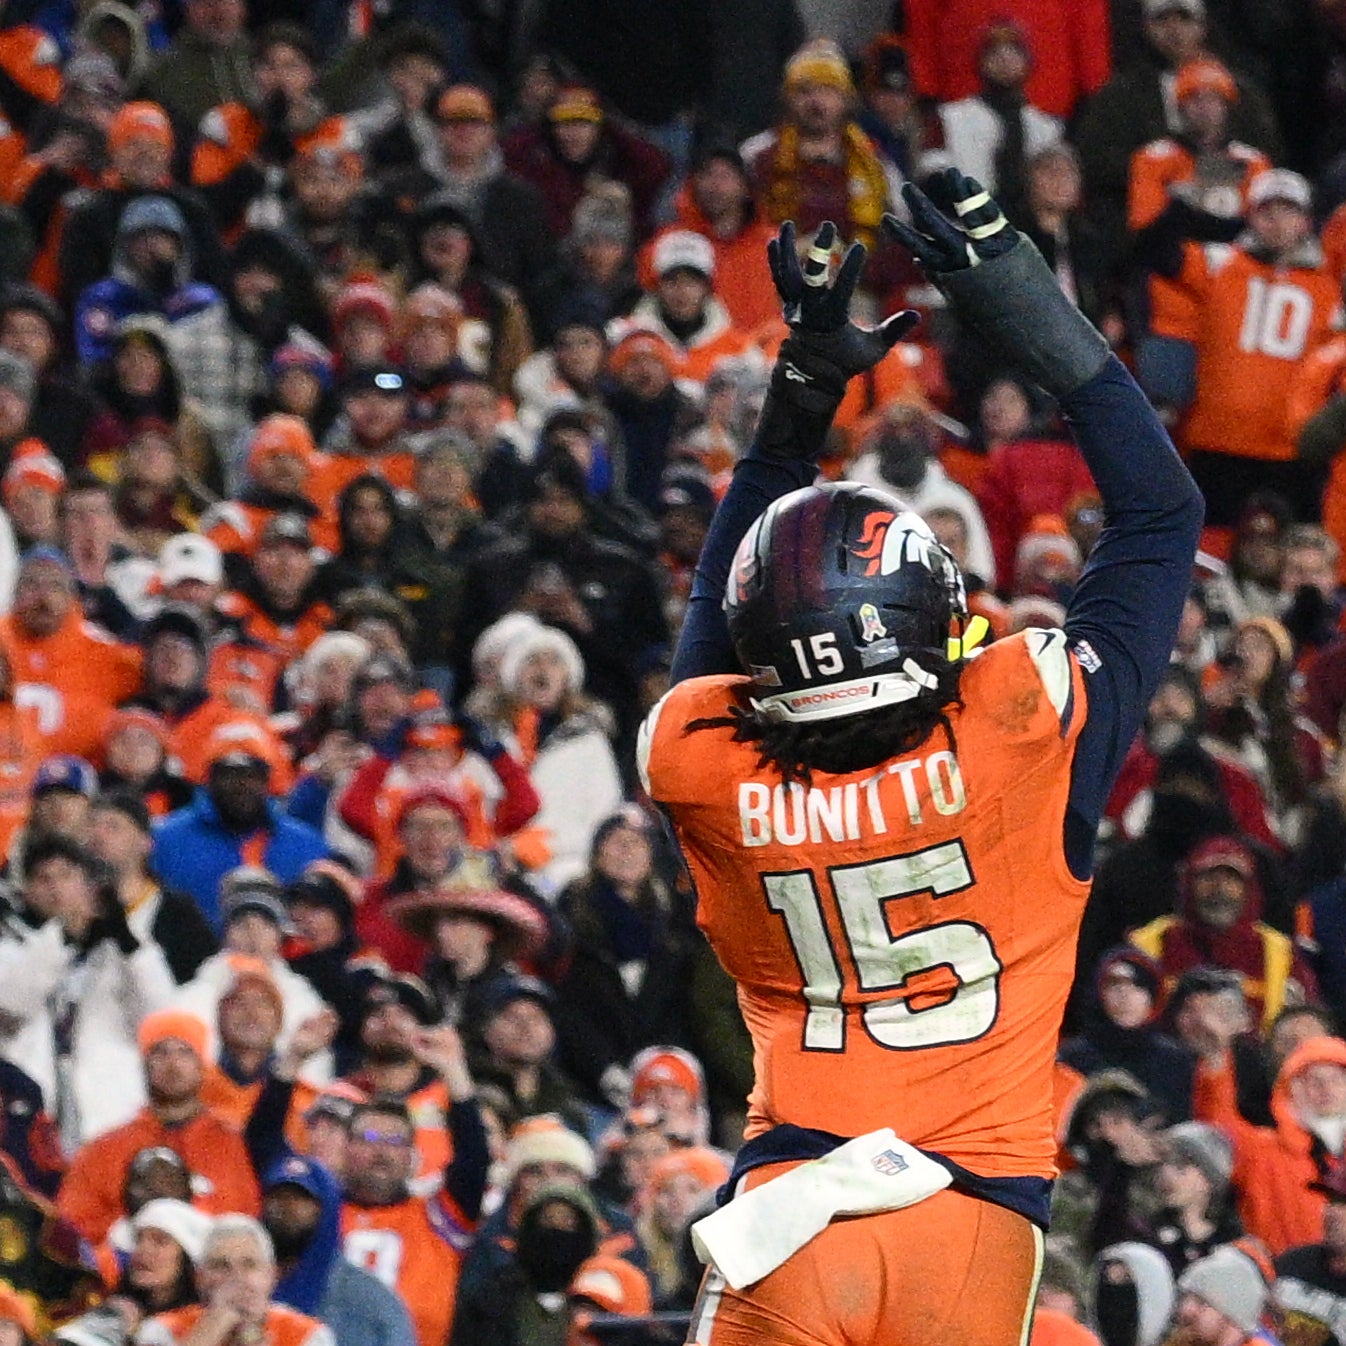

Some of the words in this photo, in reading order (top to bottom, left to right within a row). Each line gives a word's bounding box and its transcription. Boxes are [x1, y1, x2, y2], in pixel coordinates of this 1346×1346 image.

[1239, 277, 1314, 360] 10
[790, 632, 840, 679] 15
[790, 684, 870, 708] BRONCOS
[738, 749, 968, 848] BONITTO
[759, 836, 1004, 1054] 15
